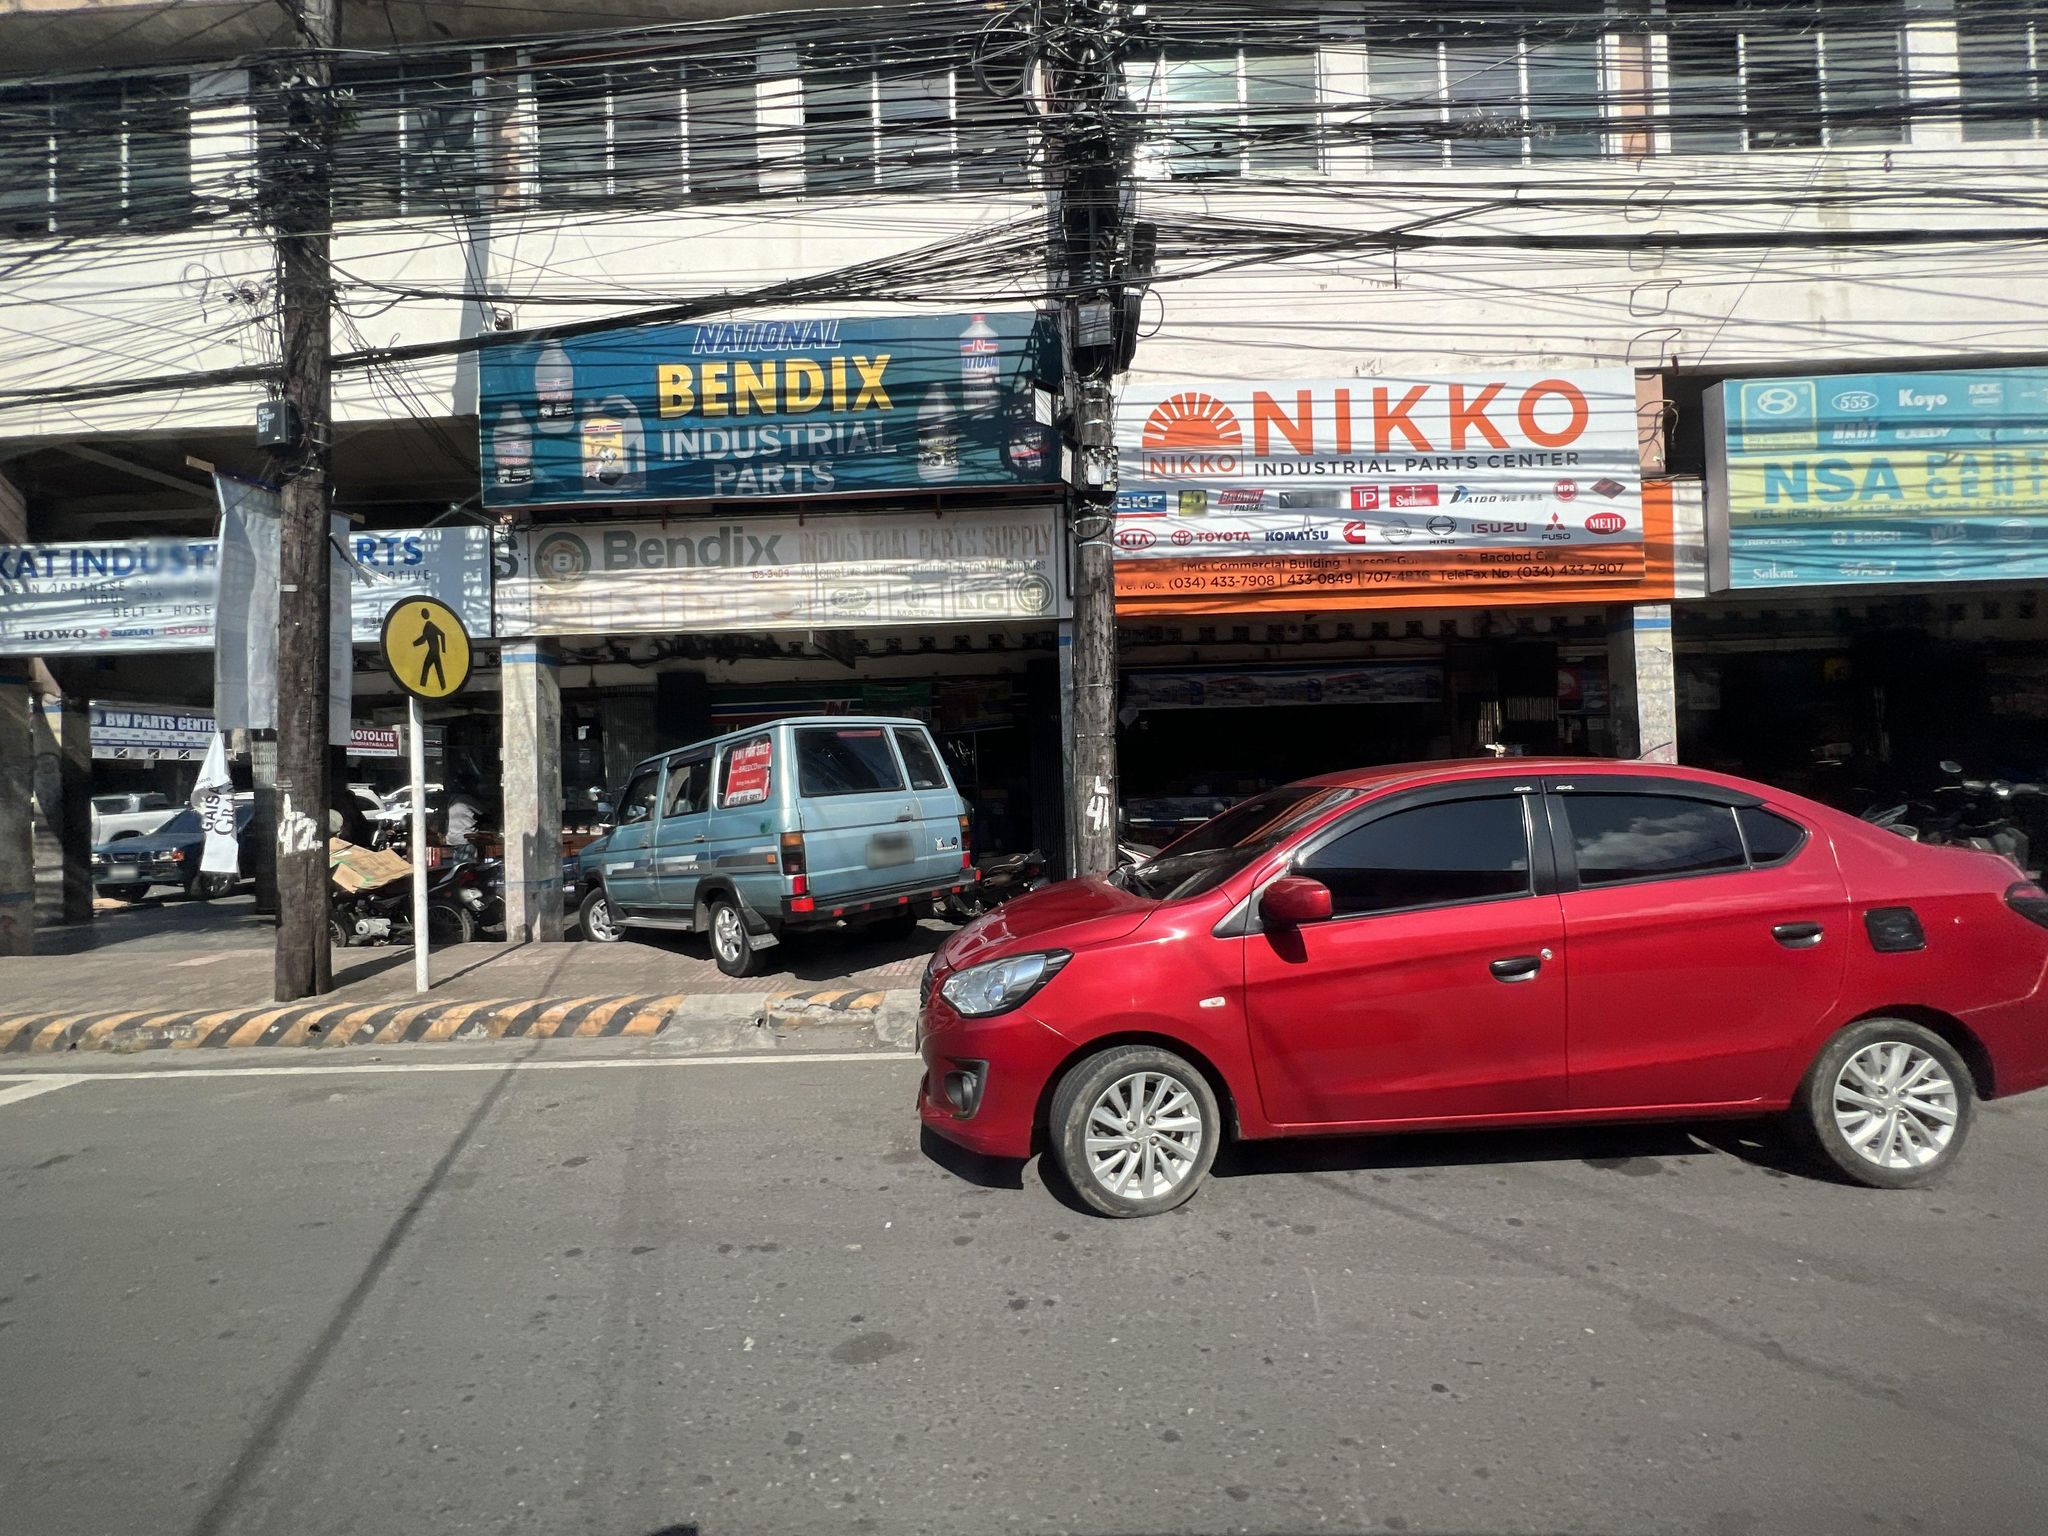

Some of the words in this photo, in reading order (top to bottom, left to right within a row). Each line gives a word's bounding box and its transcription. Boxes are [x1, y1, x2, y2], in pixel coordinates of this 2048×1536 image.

[692, 320, 841, 354] NATIONAL
[656, 354, 894, 419] BENDIX
[1839, 395, 1870, 409] 555
[1898, 388, 1949, 411] Koyo
[1252, 379, 1589, 457] NIKKO
[661, 419, 898, 461] INDUSTRIAL
[1149, 454, 1237, 475] NIKKO
[1254, 458, 1397, 477] INDUSTRIAL
[1405, 455, 1478, 472] PARTS
[1486, 451, 1580, 469] CENTER
[713, 460, 835, 497] PARTS
[1763, 457, 1905, 504] NSA
[1925, 474, 2044, 500] CENT
[1116, 495, 1163, 509] SKF
[1557, 485, 1576, 493] NPR
[1119, 534, 1150, 546] KIA
[1196, 531, 1251, 543] TOYOTA
[1264, 529, 1329, 542] KOMATSU
[1471, 522, 1528, 534] ISUZU
[1541, 533, 1571, 541] FUSO
[1590, 517, 1622, 533] MEIJI
[603, 525, 782, 571] Bendix
[918, 527, 977, 557] PARTS
[983, 524, 1054, 558] SUPPLY
[1211, 555, 1287, 571] Commercial
[1289, 557, 1341, 570] Building
[1479, 551, 1531, 562] Bacolod
[1168, 576, 1206, 590] (034)
[1210, 574, 1276, 588] 433-7908
[1287, 572, 1353, 585] 433-0849
[1440, 568, 1488, 581] TeleFax
[1491, 568, 1513, 579] No.
[1517, 566, 1555, 578] (034)
[1559, 562, 1625, 576] 433-7907
[113, 606, 147, 618] BELT
[173, 604, 212, 616] HOSE
[23, 628, 89, 641] HOWO
[110, 627, 154, 637] SUZUKI
[104, 712, 131, 728] BW
[133, 714, 175, 730] PARTS
[177, 717, 217, 732] CENTE
[1094, 775, 1110, 794] L
[1086, 795, 1110, 831] 41
